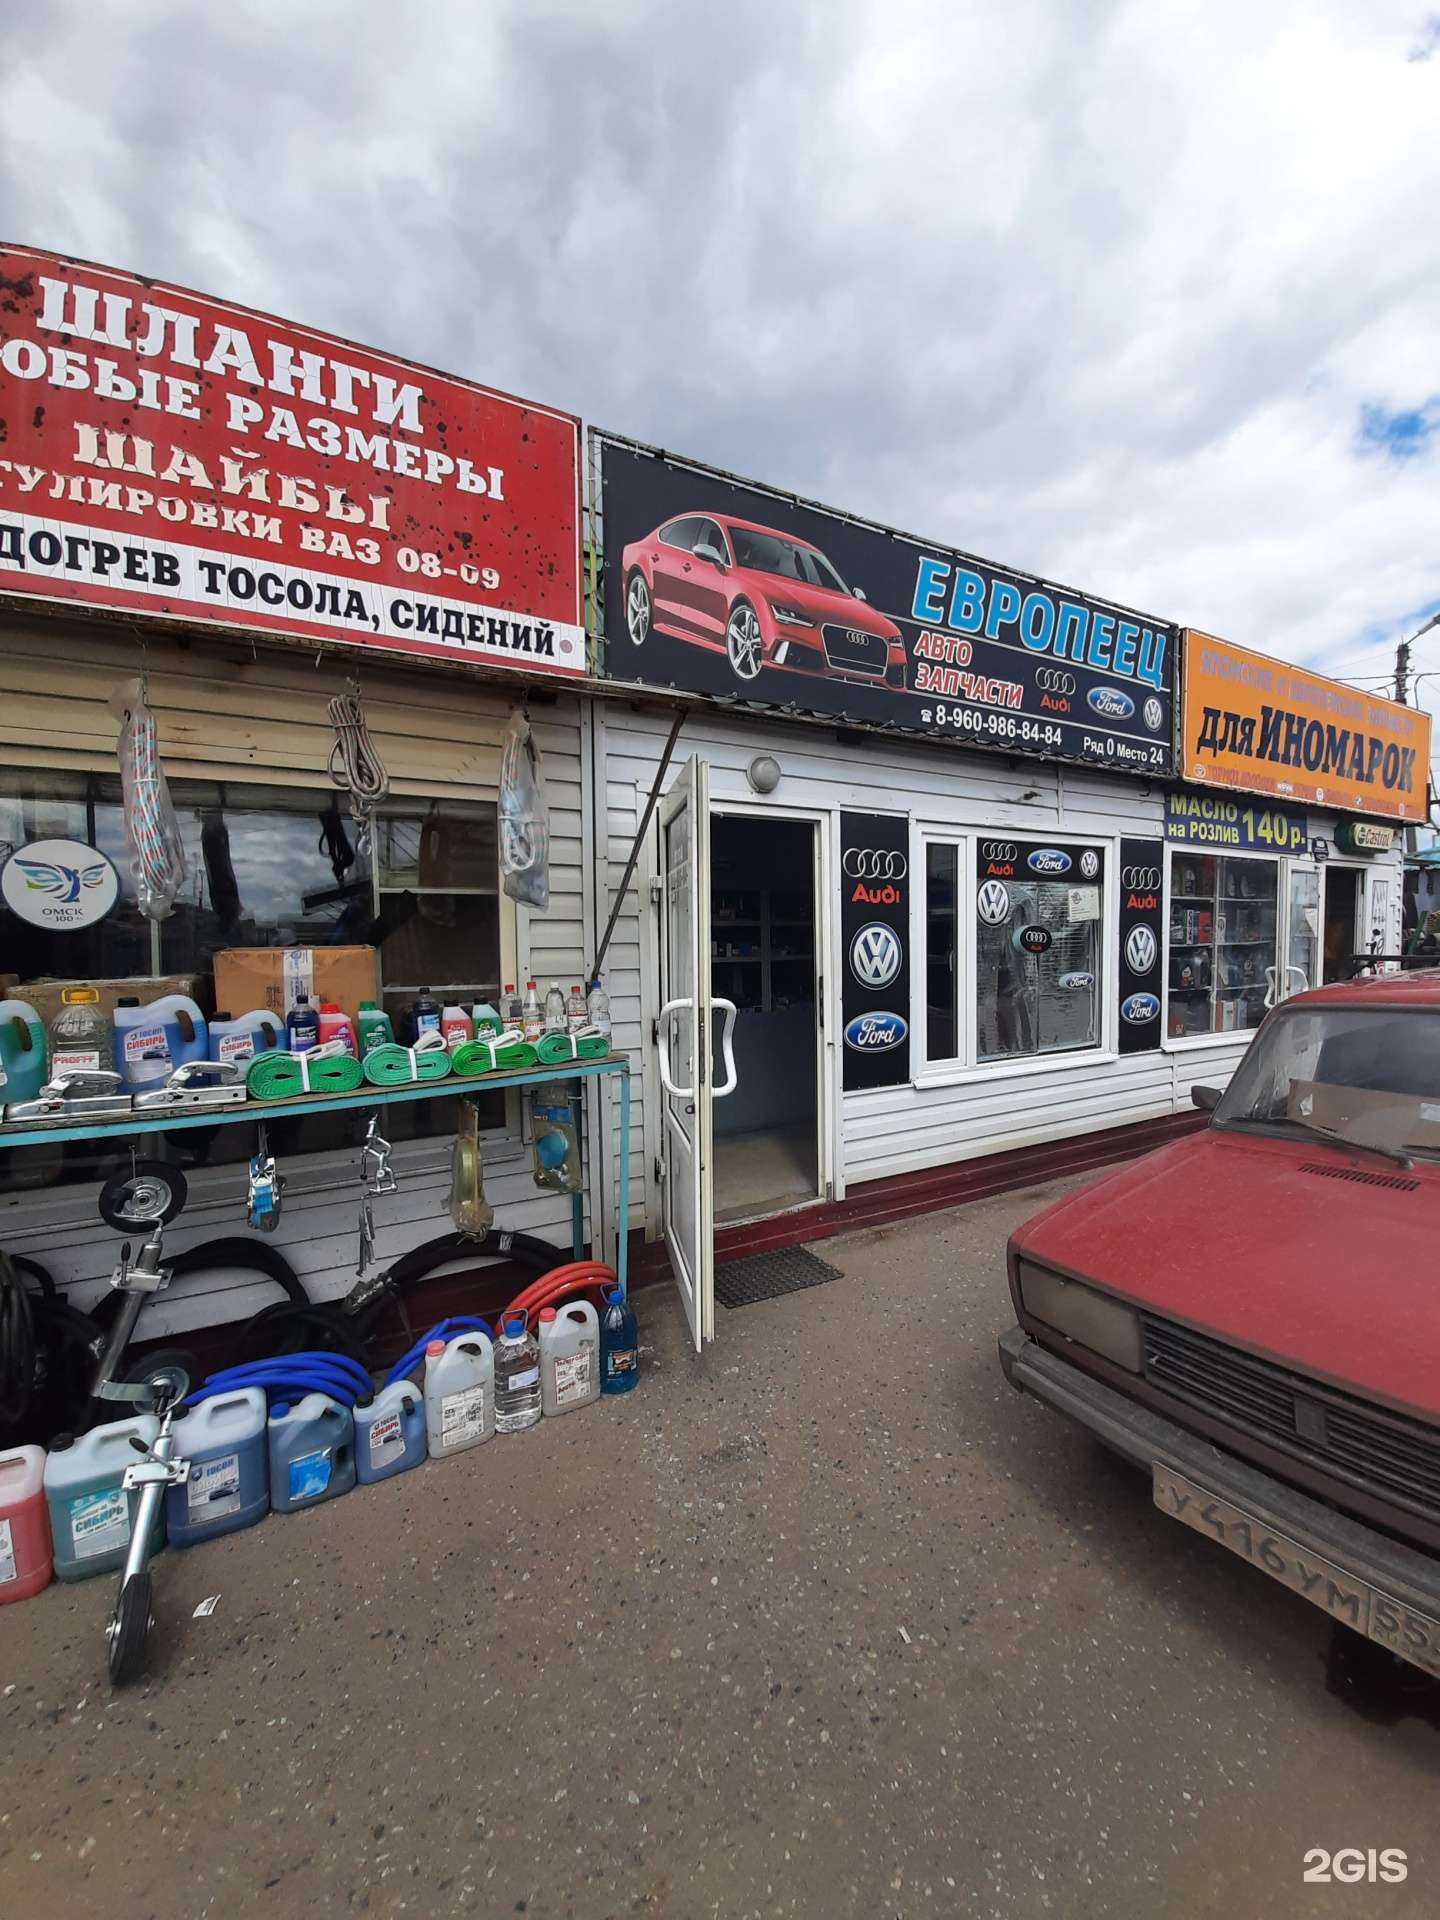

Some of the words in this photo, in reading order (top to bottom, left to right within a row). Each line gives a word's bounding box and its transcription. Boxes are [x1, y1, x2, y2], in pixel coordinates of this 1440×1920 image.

[36, 276, 424, 433] ШЛАНГИ
[226, 392, 505, 501] РАЗМЕРЫ
[73, 420, 392, 532] ШАЙБЫ
[300, 524, 381, 565] ВАЗ
[397, 545, 501, 590] 08-09
[199, 559, 381, 631] ТОСОЛА,
[390, 598, 555, 657] СИДЕНИЙ
[911, 556, 1166, 692] ЕВРОПЕЕЦ
[914, 631, 973, 666] АВТО
[915, 664, 1023, 709] ЗАПЧАСТИ
[1040, 693, 1071, 713] Audi
[1097, 690, 1126, 715] Ford
[936, 704, 1062, 746] 8-960-986-84-84
[1083, 737, 1104, 756] Ряд
[1117, 743, 1147, 762] Место
[1150, 747, 1163, 765] 24
[1256, 705, 1416, 793] ИНОМАРОК
[1170, 793, 1238, 823] МАСЛО
[1168, 822, 1186, 837] на
[1190, 821, 1240, 844] РОЗЛИВ
[1242, 808, 1288, 846] 140
[987, 863, 1014, 875] Audi
[1036, 852, 1063, 870] Ford
[851, 883, 901, 904] Audi
[1127, 895, 1157, 909] Audi
[1128, 996, 1154, 1018] Ford
[857, 1014, 896, 1045] Ford
